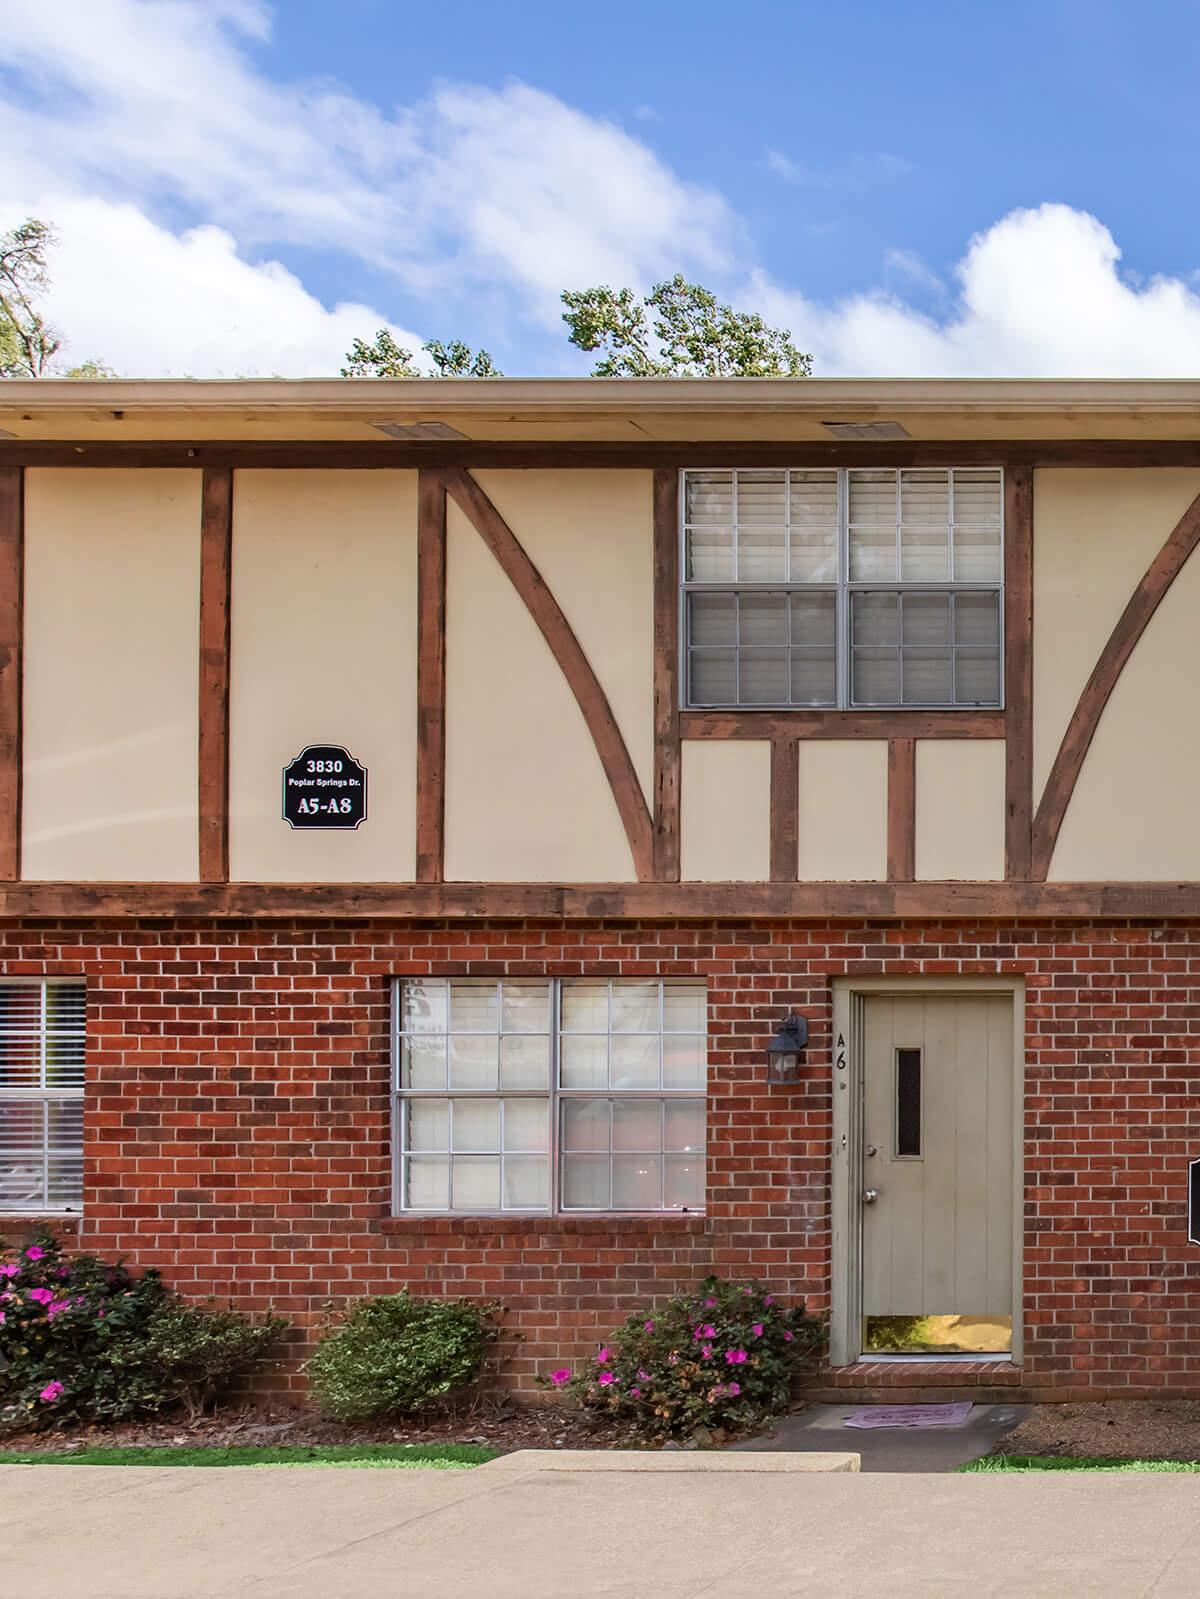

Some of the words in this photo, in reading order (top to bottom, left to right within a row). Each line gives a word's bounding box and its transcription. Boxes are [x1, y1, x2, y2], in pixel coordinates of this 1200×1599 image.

[306, 760, 343, 773] 3830
[288, 778, 315, 787] Poplar
[316, 778, 347, 788] Springs
[349, 778, 361, 786] Dr.
[297, 797, 352, 815] A5-A8
